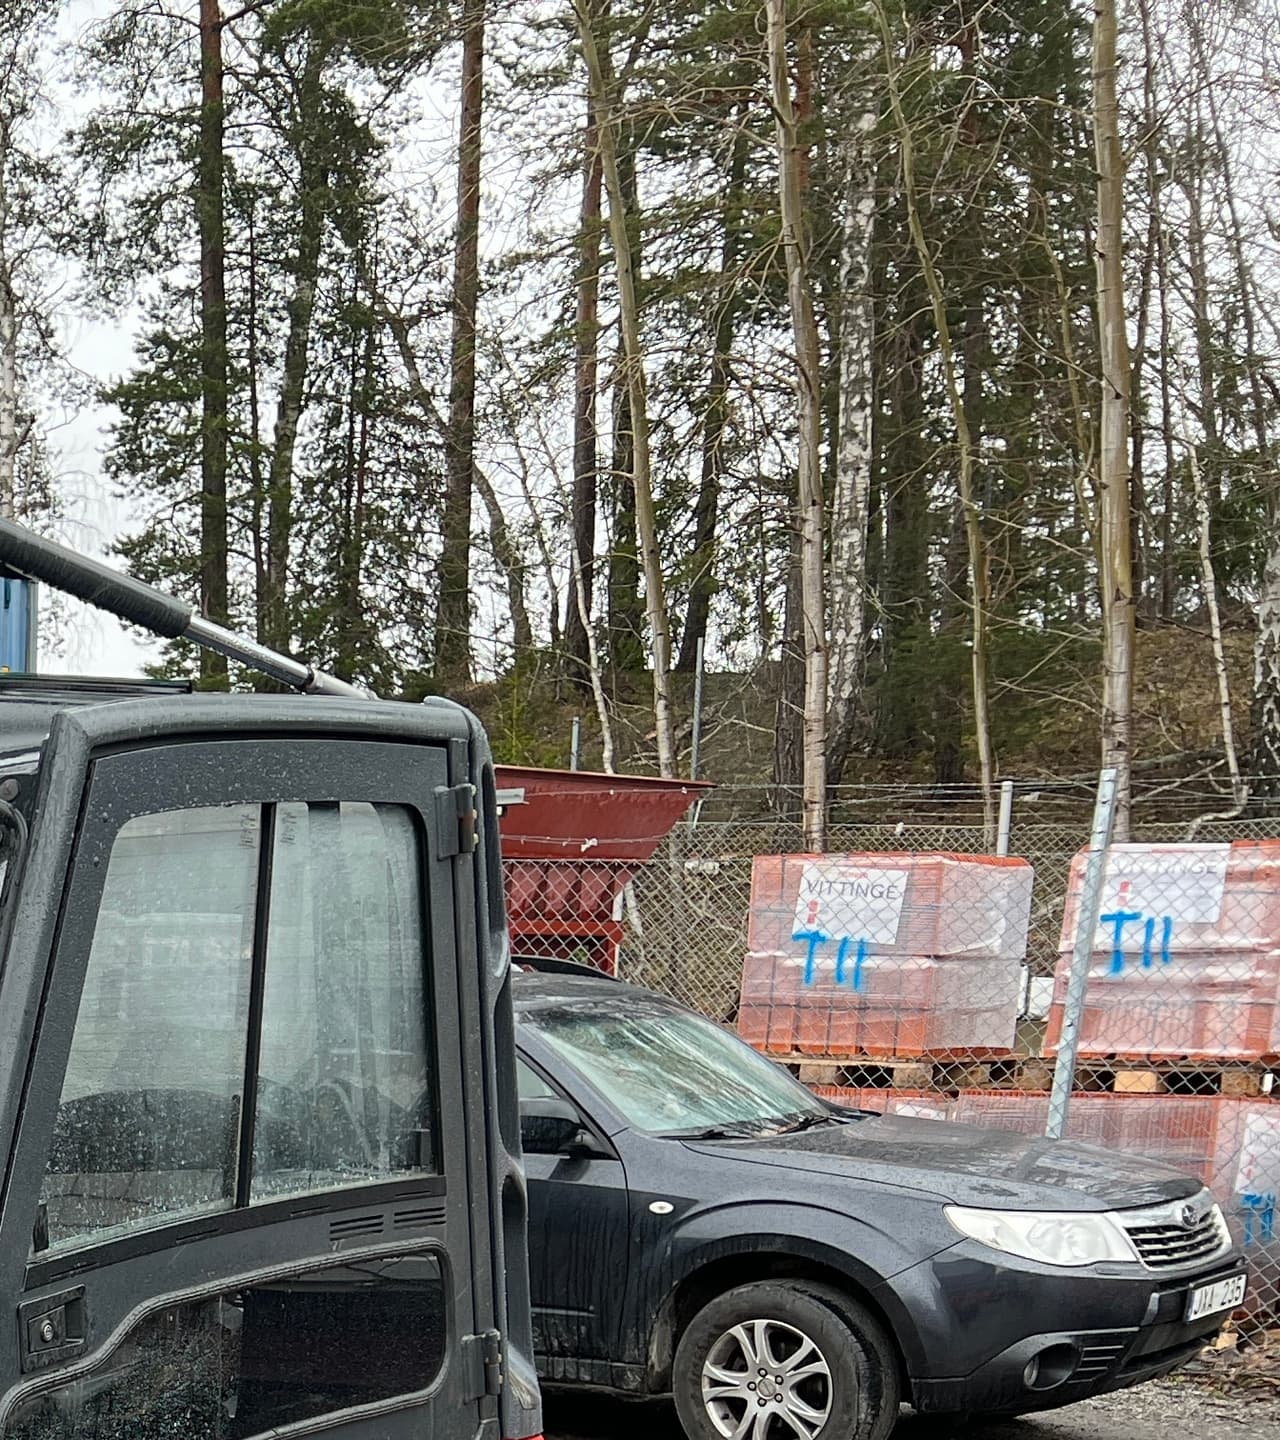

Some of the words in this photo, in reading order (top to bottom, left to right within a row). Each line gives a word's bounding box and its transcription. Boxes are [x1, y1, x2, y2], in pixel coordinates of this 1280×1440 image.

[805, 878, 900, 901] VITTINGE
[1192, 1285, 1214, 1316] JXA
[1220, 1274, 1244, 1307] 235
